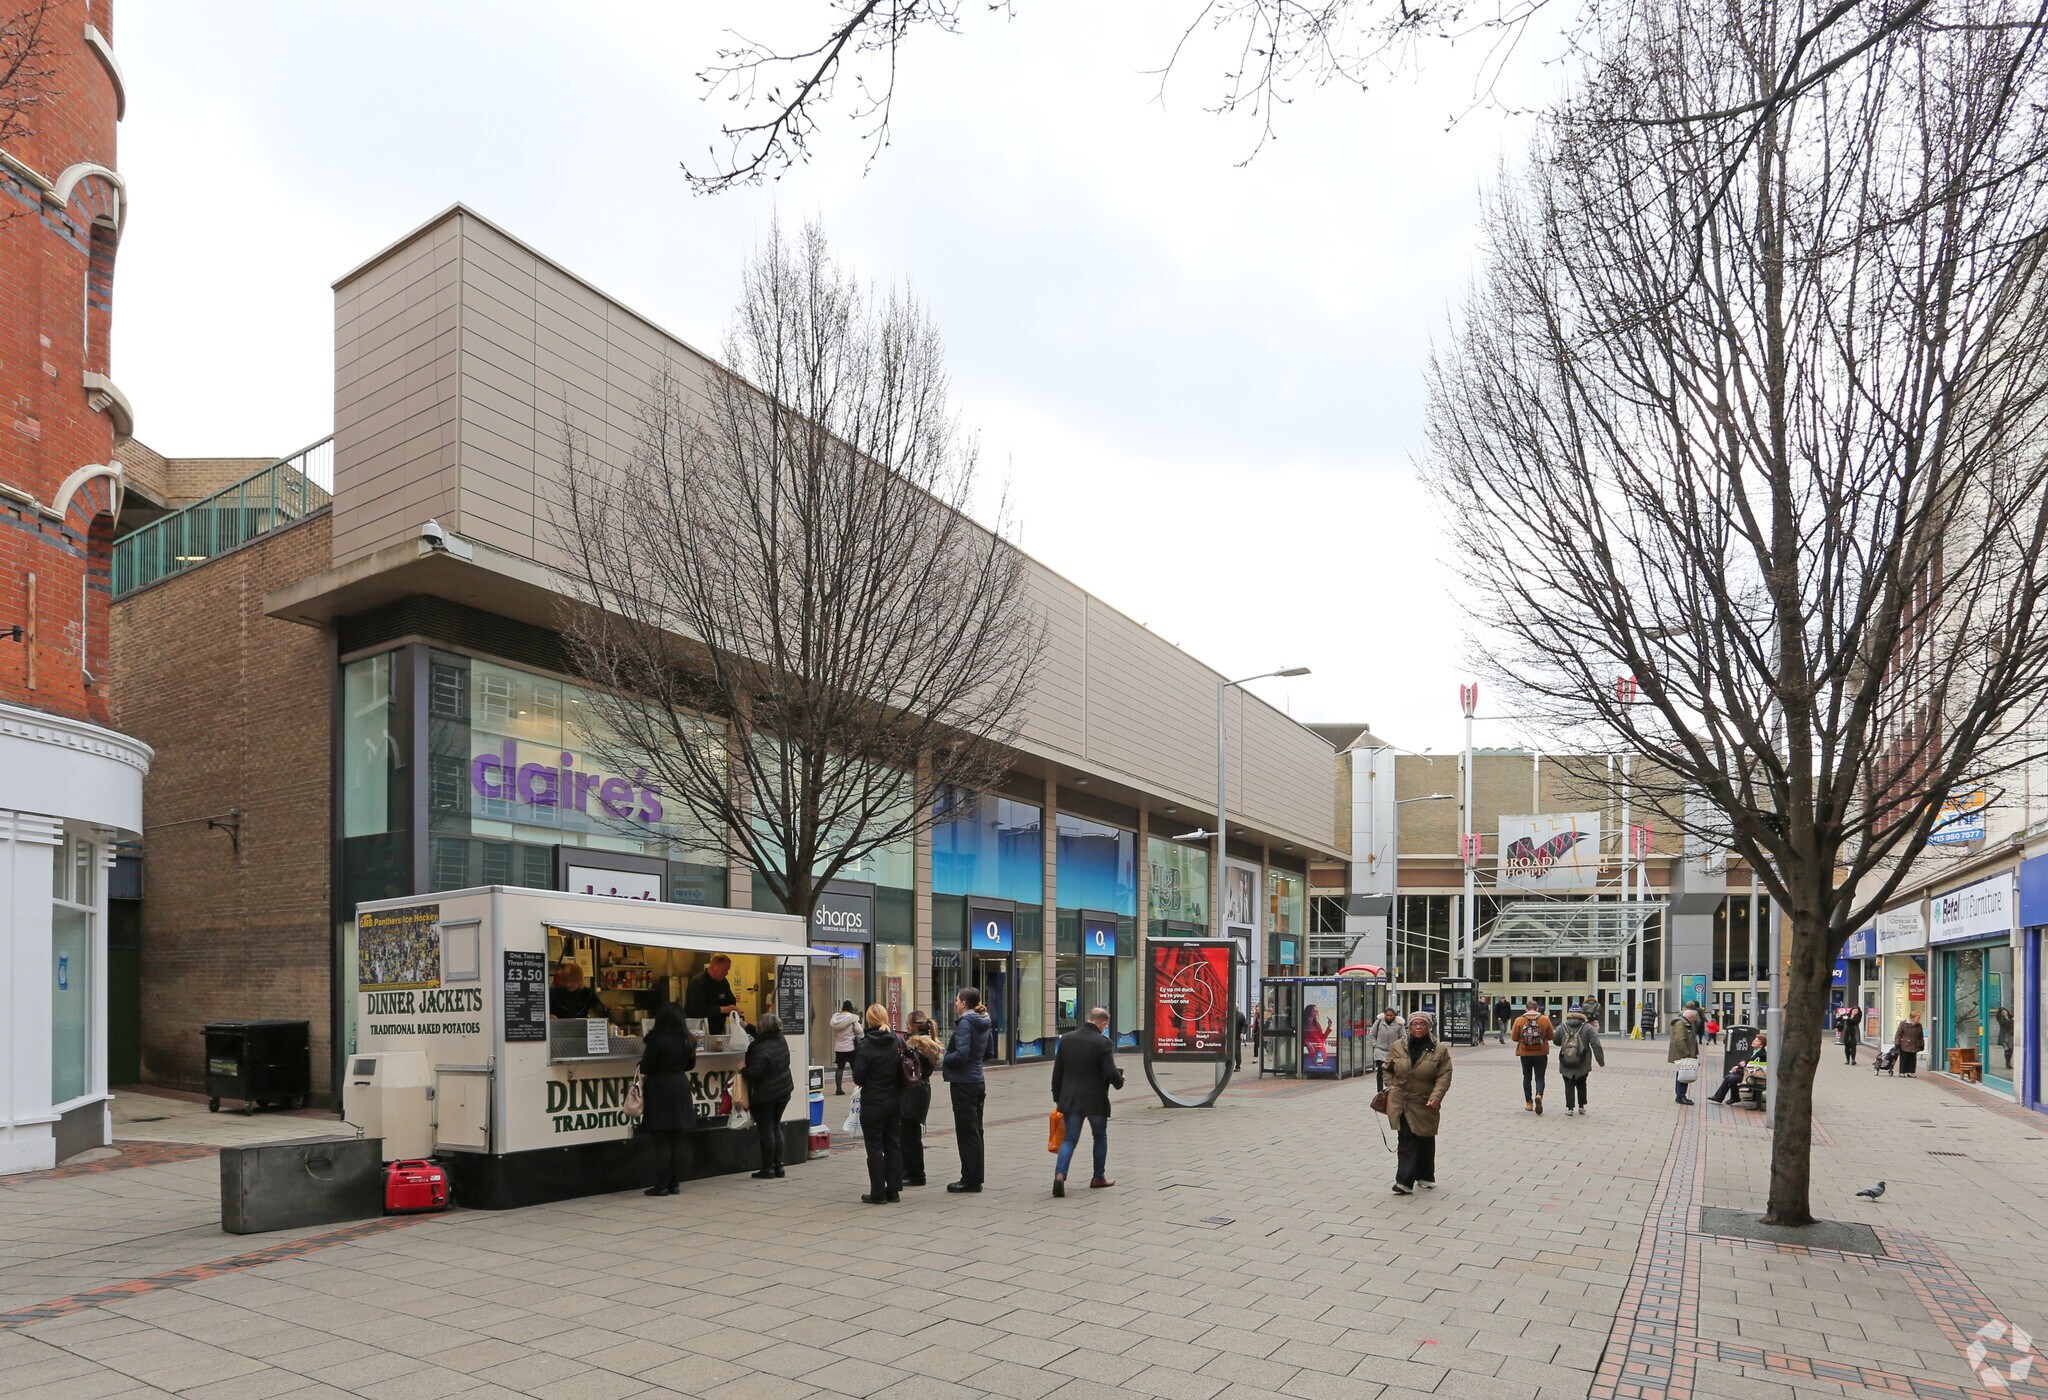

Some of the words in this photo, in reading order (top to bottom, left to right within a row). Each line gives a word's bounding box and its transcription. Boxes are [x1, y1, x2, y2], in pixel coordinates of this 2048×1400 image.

[471, 738, 664, 823] claire's
[1961, 830, 1980, 839] 7577
[374, 916, 402, 926] Panthers
[414, 914, 438, 922] Hockey
[816, 904, 862, 932] sharps
[508, 968, 542, 980] £3.50
[781, 978, 803, 988] £3.50
[367, 992, 415, 1015] DINNER
[419, 988, 482, 1014] JACKETS
[370, 1024, 416, 1035] TRADITIONAL
[418, 1023, 440, 1034] BAKED
[442, 1022, 480, 1034] POTATOES
[546, 1074, 645, 1113] DINNE
[553, 1110, 643, 1132] TRADITION
